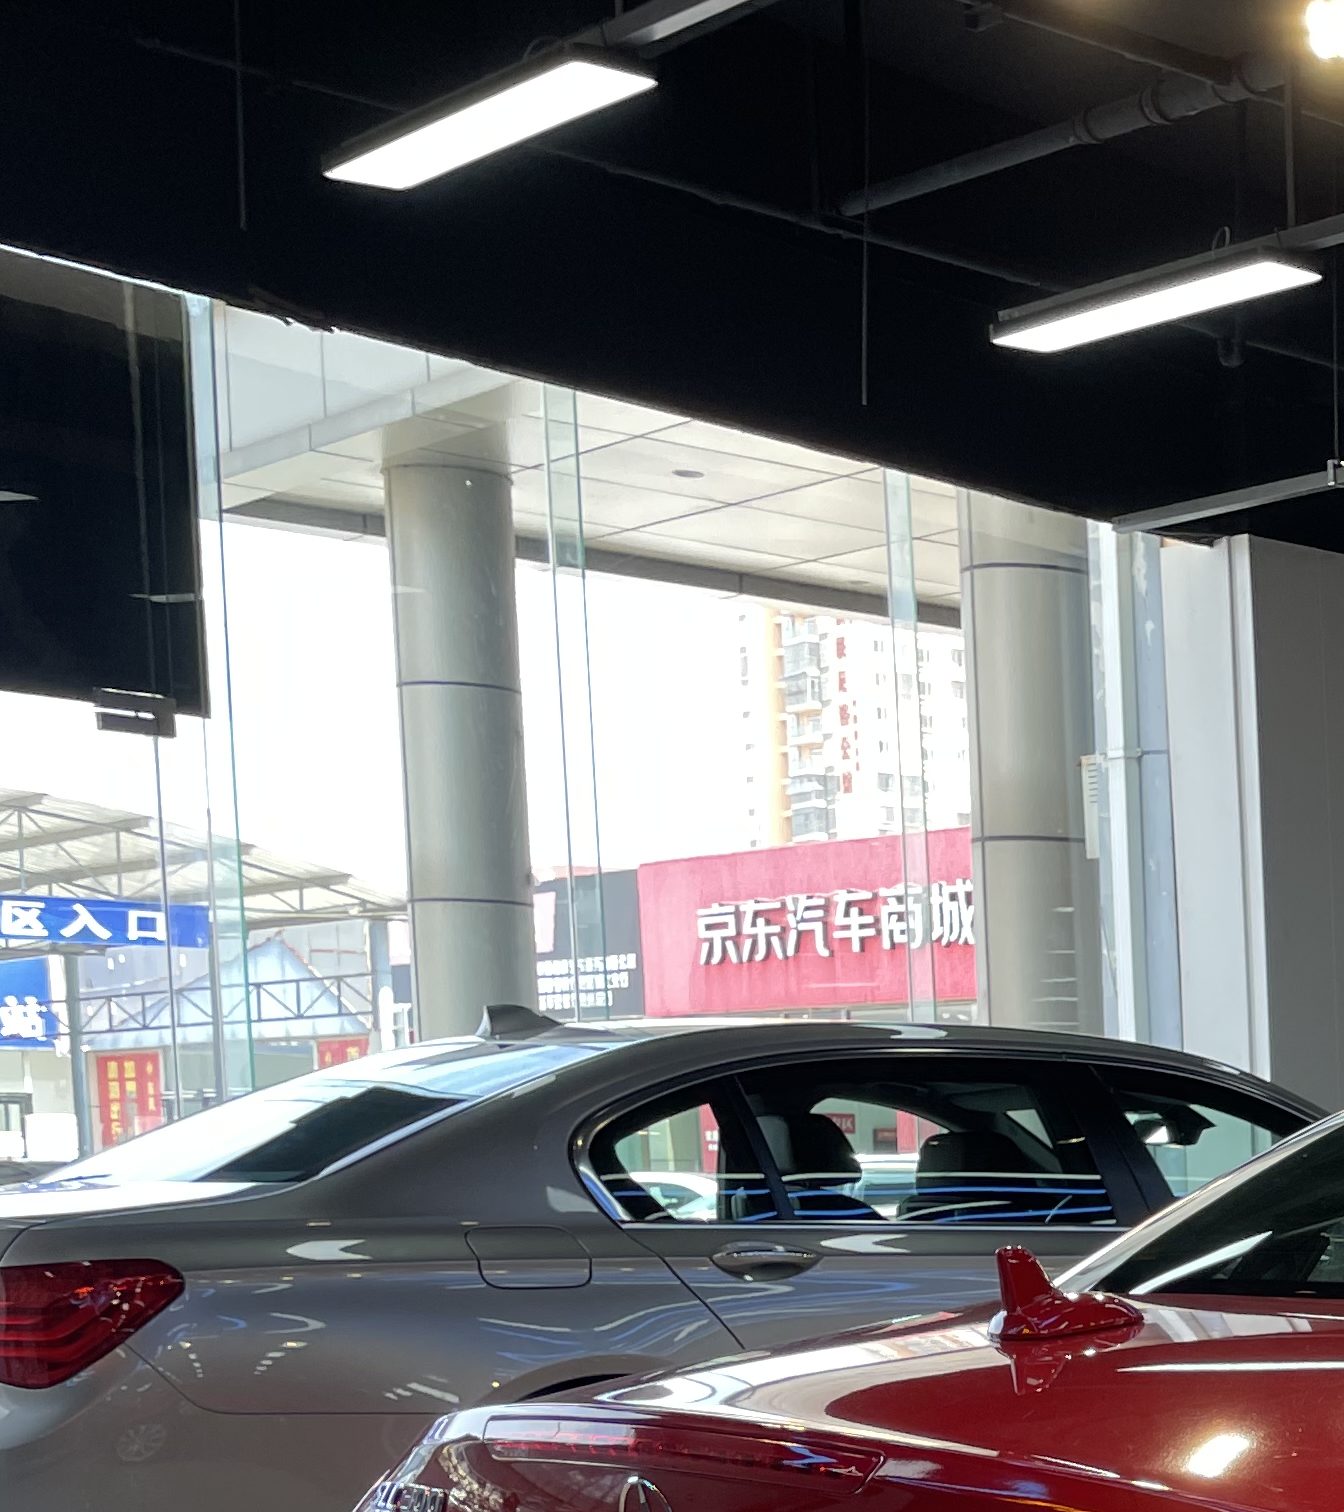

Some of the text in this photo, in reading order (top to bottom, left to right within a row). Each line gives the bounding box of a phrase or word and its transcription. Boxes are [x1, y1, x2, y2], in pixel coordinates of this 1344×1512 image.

[1, 901, 167, 940] 区入口
[697, 878, 976, 965] 京东汽车商城
